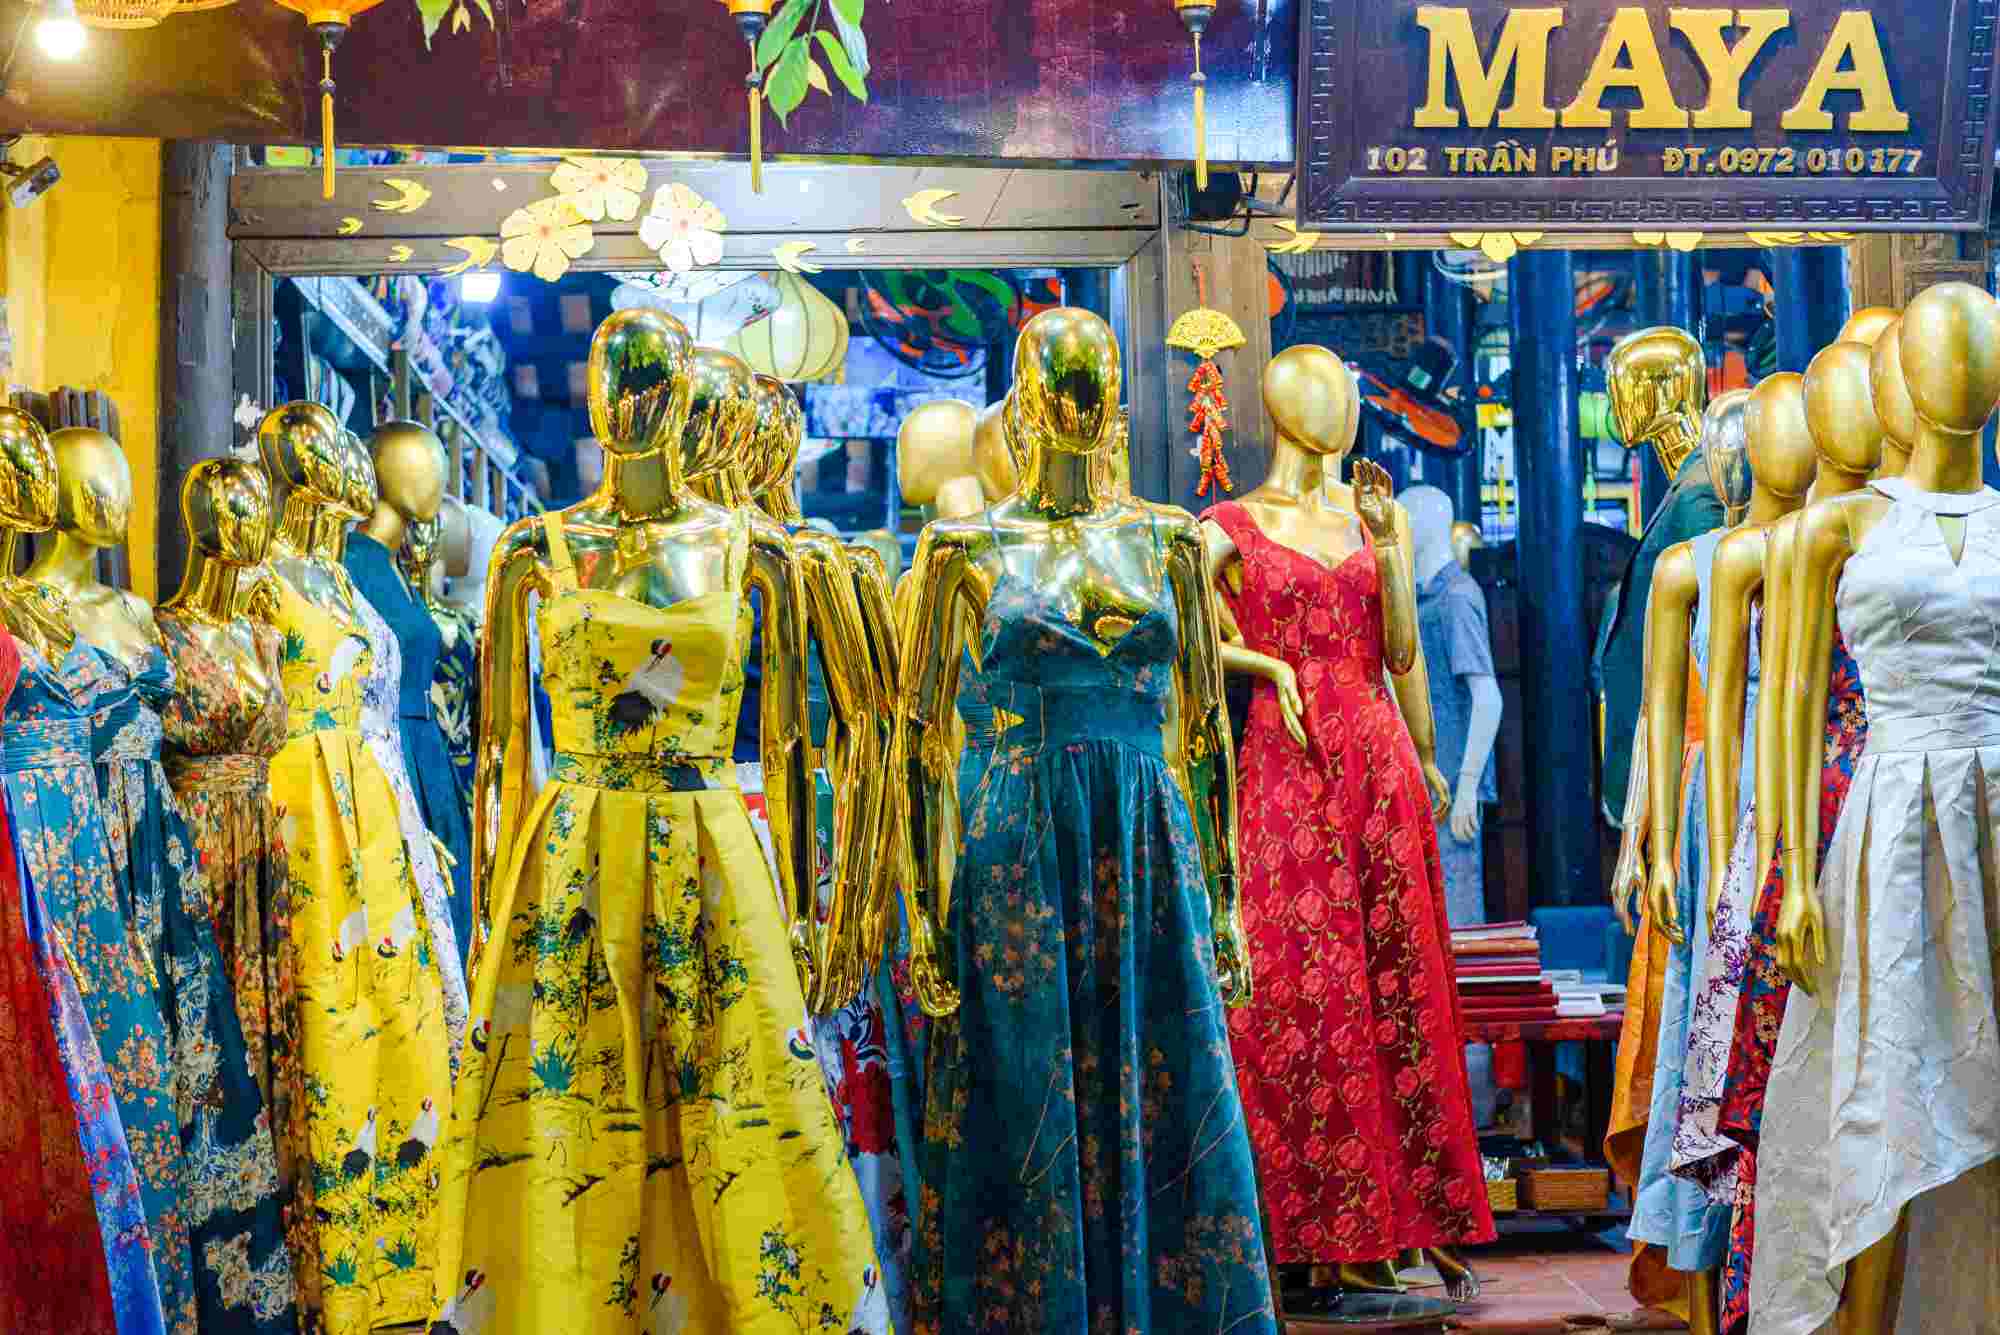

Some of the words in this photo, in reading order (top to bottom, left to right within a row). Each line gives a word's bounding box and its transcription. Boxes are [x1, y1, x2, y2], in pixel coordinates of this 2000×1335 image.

[1414, 7, 1909, 131] MAYA
[1367, 148, 1427, 172] 102
[1445, 139, 1537, 173] TRẦN
[1552, 138, 1618, 172] PHÚ
